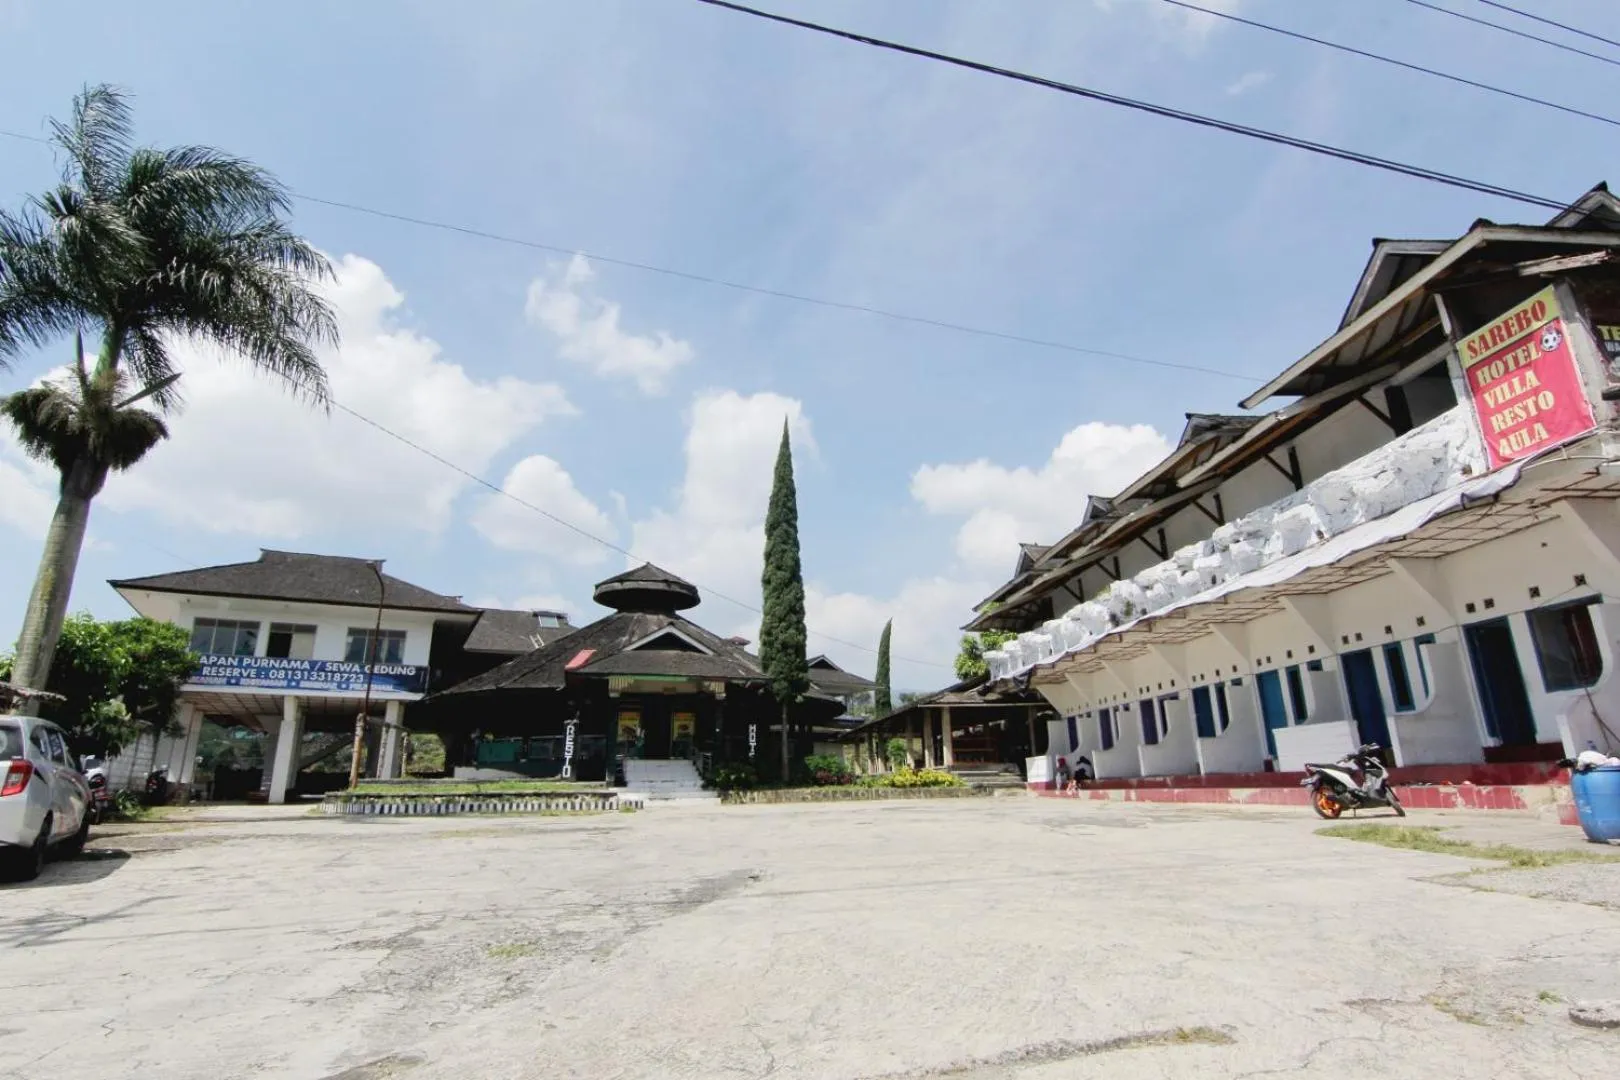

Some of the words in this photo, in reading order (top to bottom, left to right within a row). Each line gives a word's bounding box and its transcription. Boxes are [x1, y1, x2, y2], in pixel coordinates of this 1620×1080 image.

[1466, 299, 1546, 360] SAREBO
[1475, 340, 1541, 387] HOTEL
[1483, 369, 1541, 409] VILLA
[1489, 390, 1554, 434] RESTO
[1499, 422, 1549, 456] AULA
[202, 667, 257, 678] RESERVE
[269, 670, 364, 682] 081313318723
[242, 658, 310, 670] PURNAMA
[324, 662, 360, 673] SEWA
[562, 725, 575, 778] RESTO
